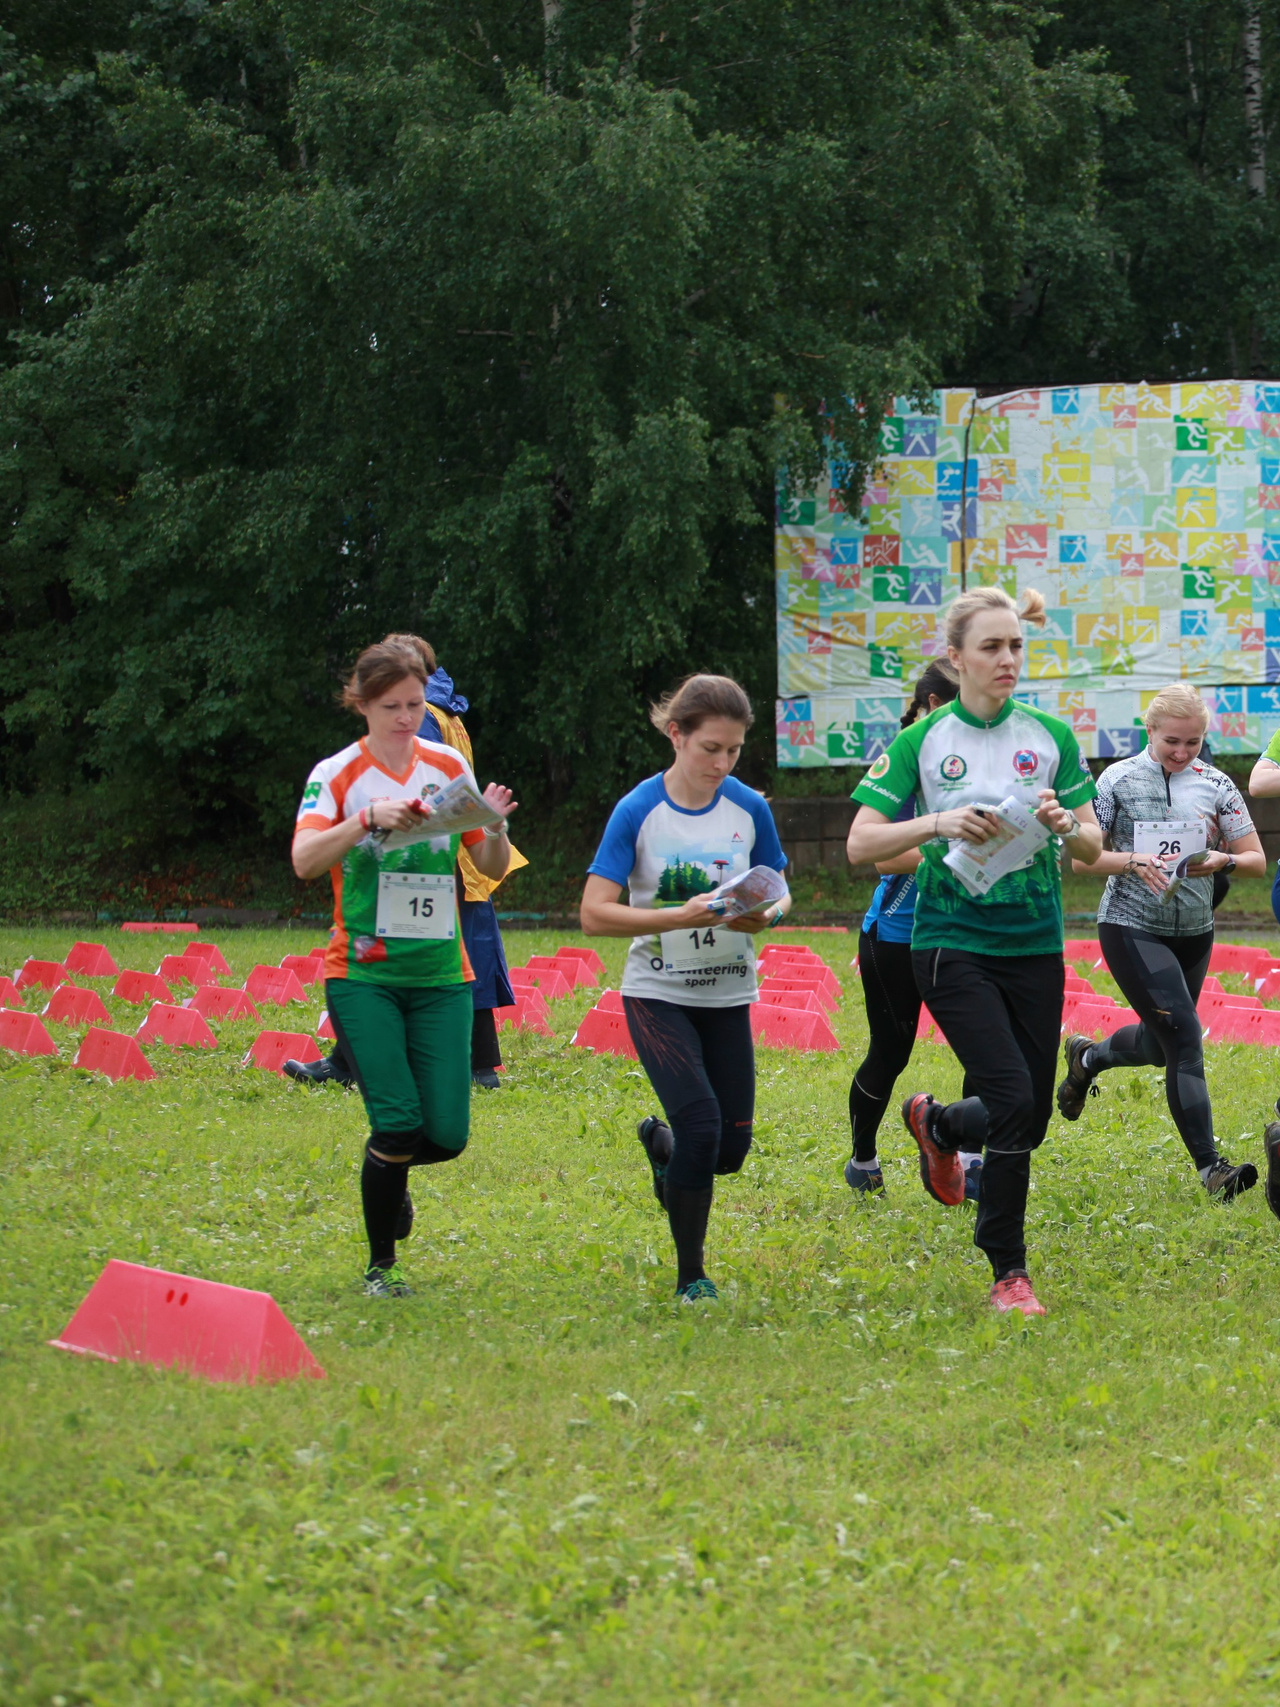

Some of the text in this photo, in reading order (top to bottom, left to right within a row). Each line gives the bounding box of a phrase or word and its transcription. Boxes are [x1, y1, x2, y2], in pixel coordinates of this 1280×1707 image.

[1159, 840, 1181, 856] 26
[884, 874, 916, 918] noname
[409, 897, 434, 918] 15
[689, 927, 716, 950] 14
[685, 977, 717, 988] sport
